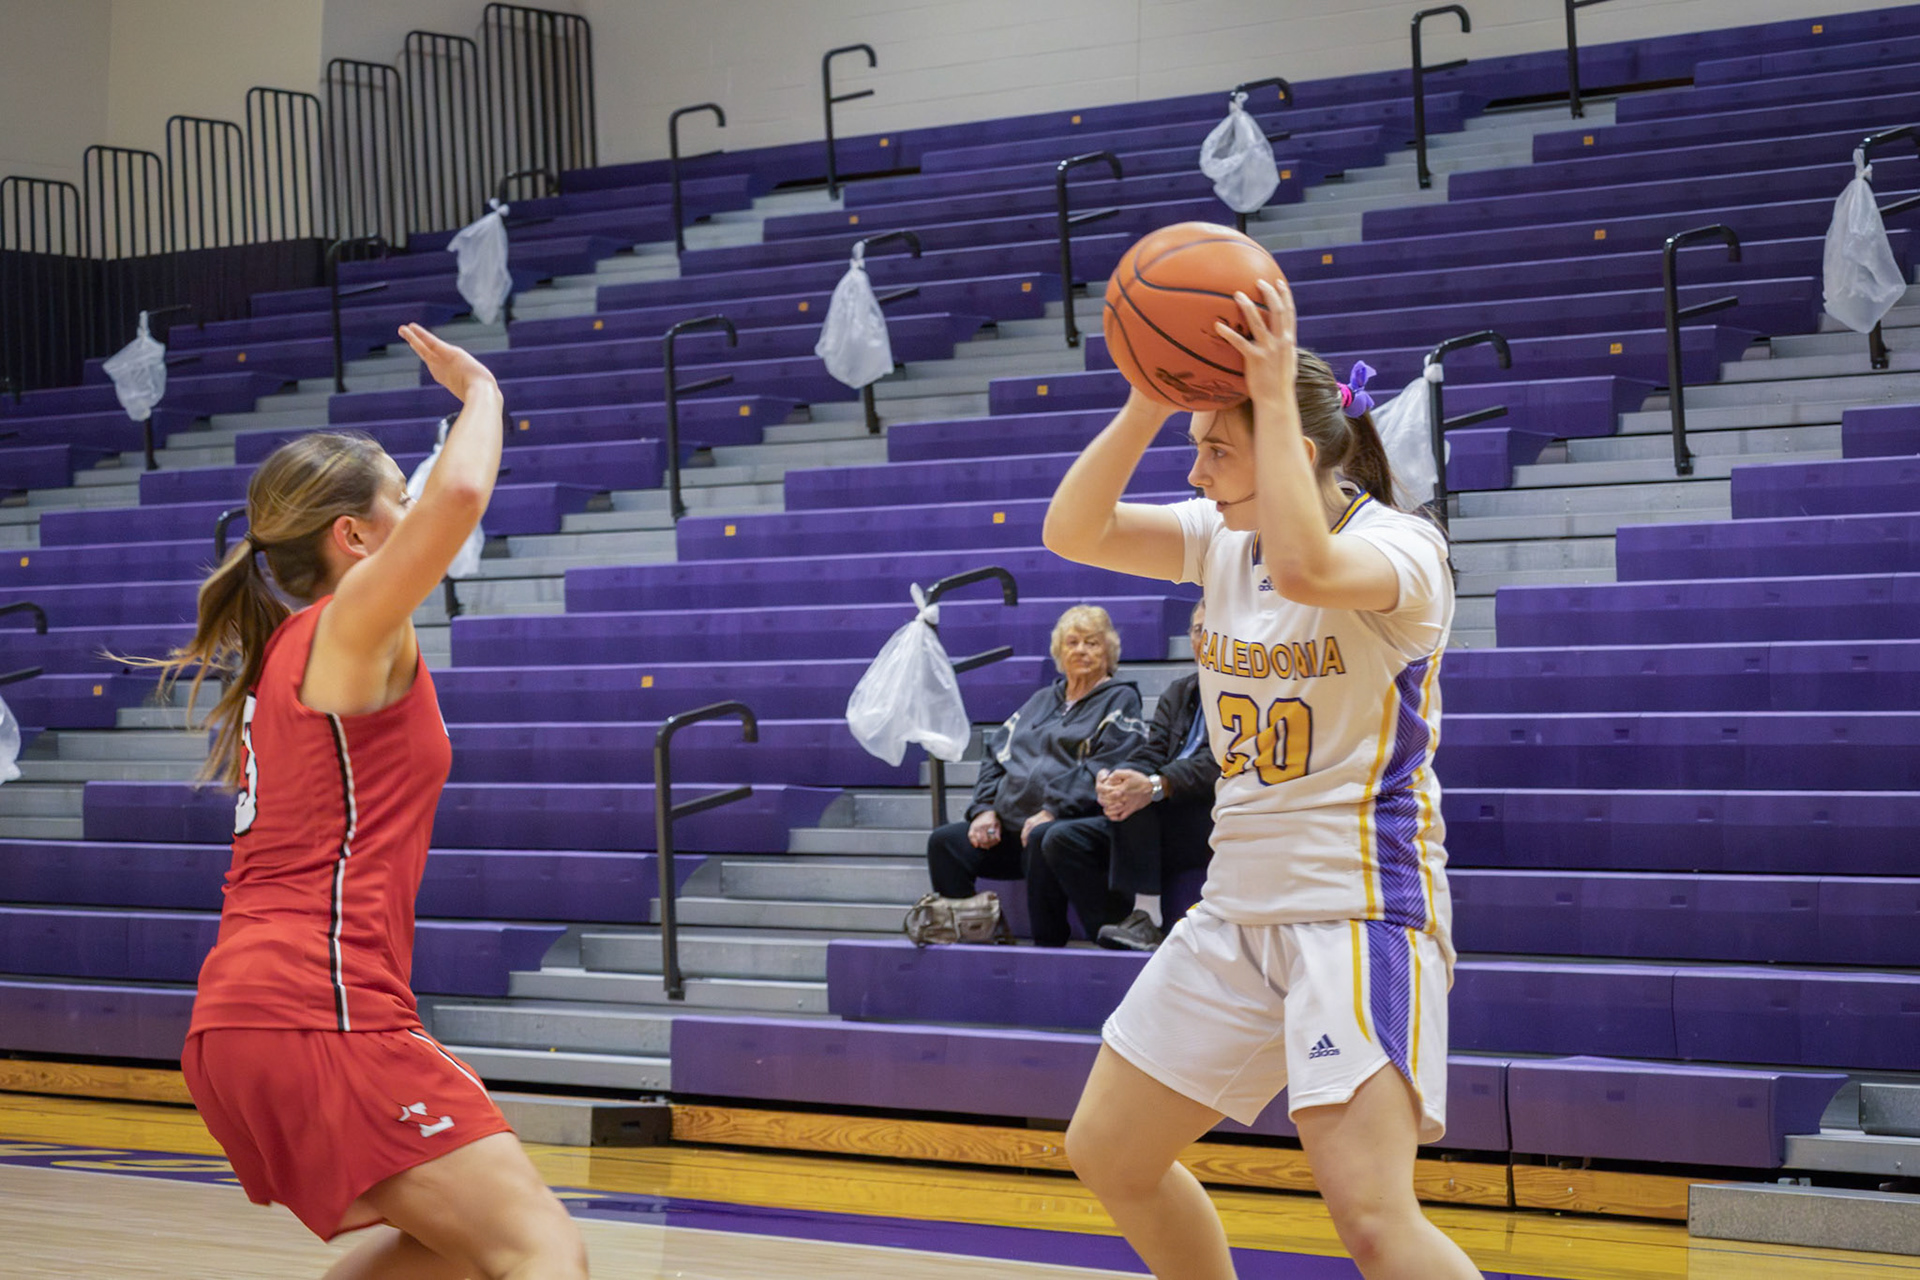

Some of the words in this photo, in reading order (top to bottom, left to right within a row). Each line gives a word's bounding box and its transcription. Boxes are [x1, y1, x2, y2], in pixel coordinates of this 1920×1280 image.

[1199, 629, 1346, 680] CALEDONIA
[1217, 691, 1313, 787] 20
[1309, 1048, 1341, 1060] adidas
